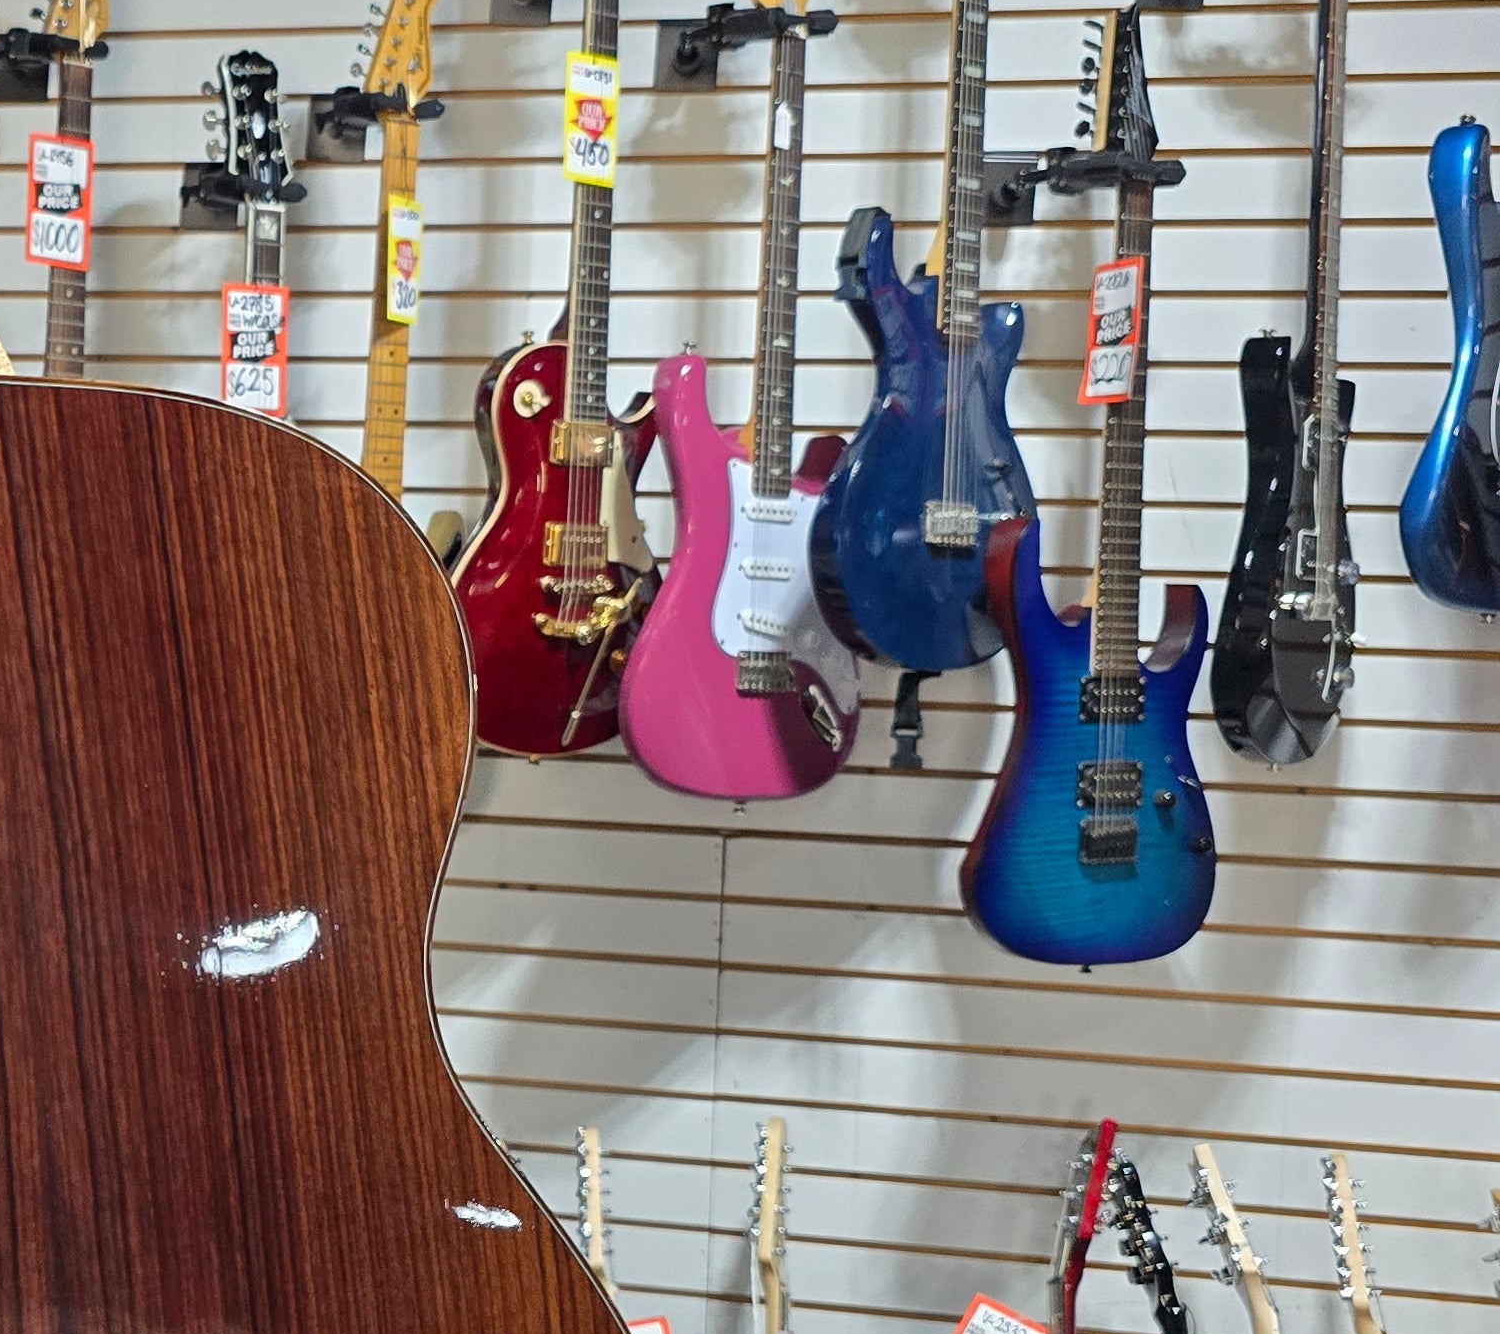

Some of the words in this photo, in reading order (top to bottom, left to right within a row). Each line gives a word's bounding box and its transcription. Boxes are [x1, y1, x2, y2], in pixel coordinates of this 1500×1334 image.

[42, 183, 75, 198] OUR
[37, 195, 80, 209] PRICE
[32, 220, 78, 254] $1000
[1100, 310, 1126, 330] OUR
[237, 332, 269, 346] OUR
[1096, 318, 1133, 345] PRICE
[232, 343, 276, 360] PRICE
[227, 367, 274, 398] $625
